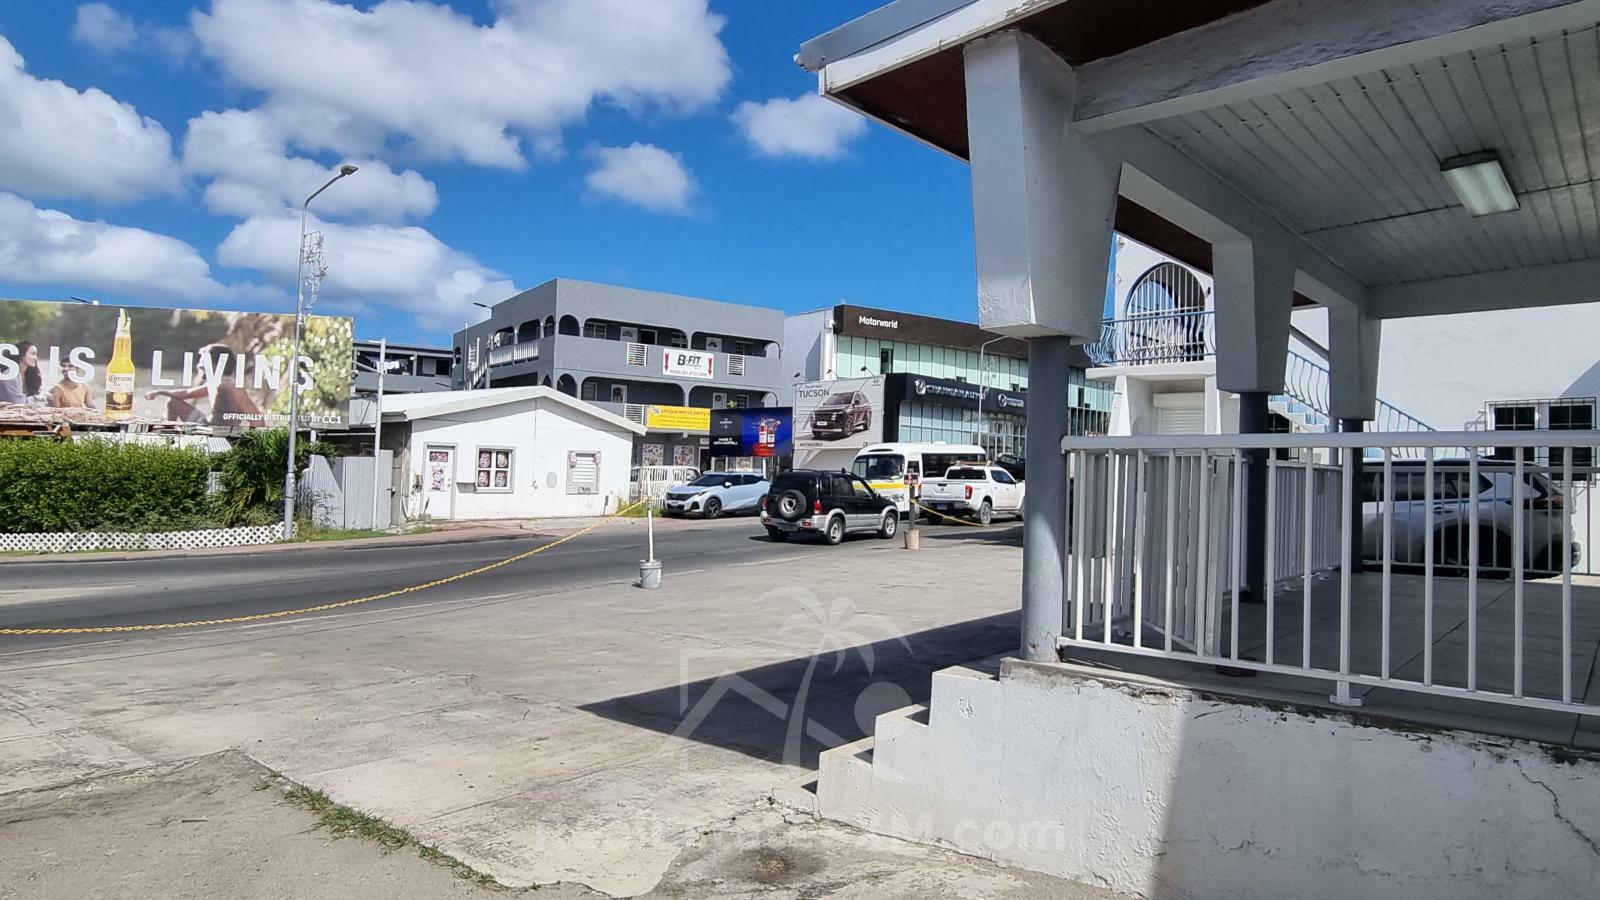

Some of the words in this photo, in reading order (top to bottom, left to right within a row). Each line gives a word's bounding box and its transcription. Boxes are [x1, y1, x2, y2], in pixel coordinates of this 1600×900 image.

[858, 315, 898, 329] Motorworld
[50, 345, 96, 384] IS
[151, 350, 315, 392] LIVING
[799, 388, 830, 398] TUCSON
[222, 412, 263, 421] OFFICIALLY
[263, 412, 310, 422] DISTRIBTED
[311, 415, 321, 423] BY
[322, 415, 342, 424] CC1
